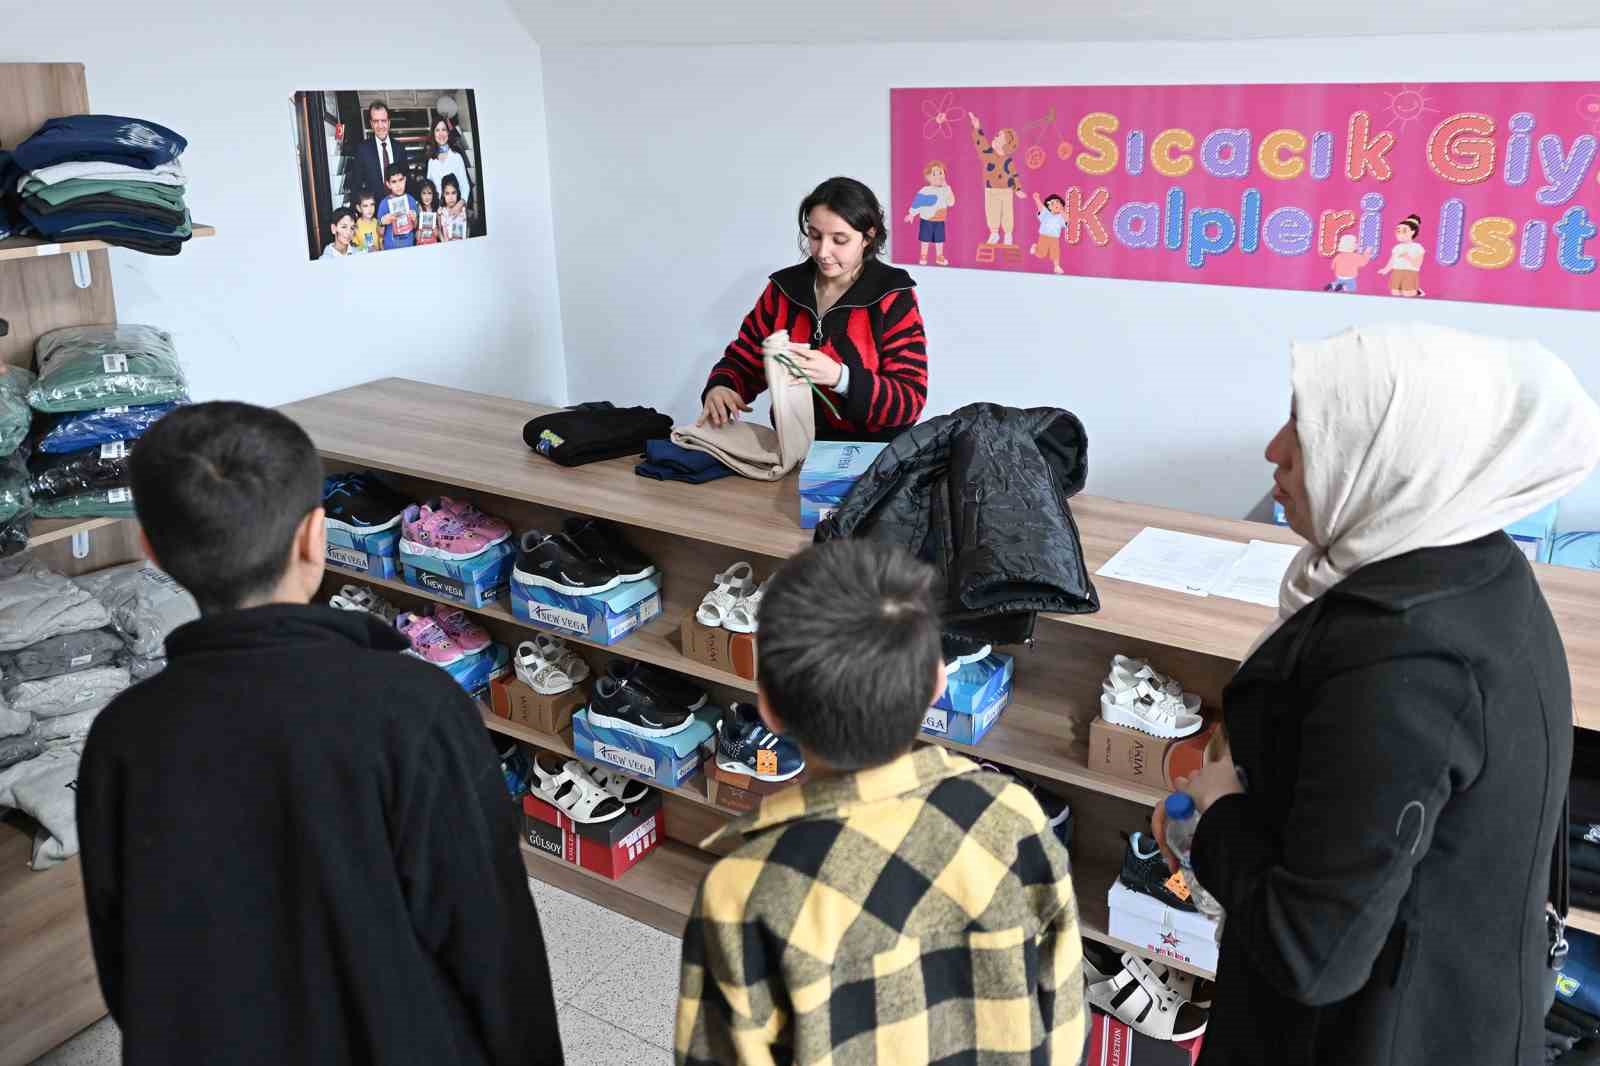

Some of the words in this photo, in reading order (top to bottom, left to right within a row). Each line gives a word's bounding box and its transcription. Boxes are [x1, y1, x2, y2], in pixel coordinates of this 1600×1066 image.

[1075, 110, 1396, 182] Sıcacık
[1426, 111, 1600, 207] Giy
[1064, 186, 1386, 269] Kalpleri
[1436, 197, 1598, 274] Isıt
[427, 578, 443, 590] NEW
[444, 583, 464, 597] VEGA
[541, 613, 560, 624] NEW
[561, 617, 587, 632] VEGA
[606, 752, 626, 766] NEW
[627, 759, 655, 776] VEGA
